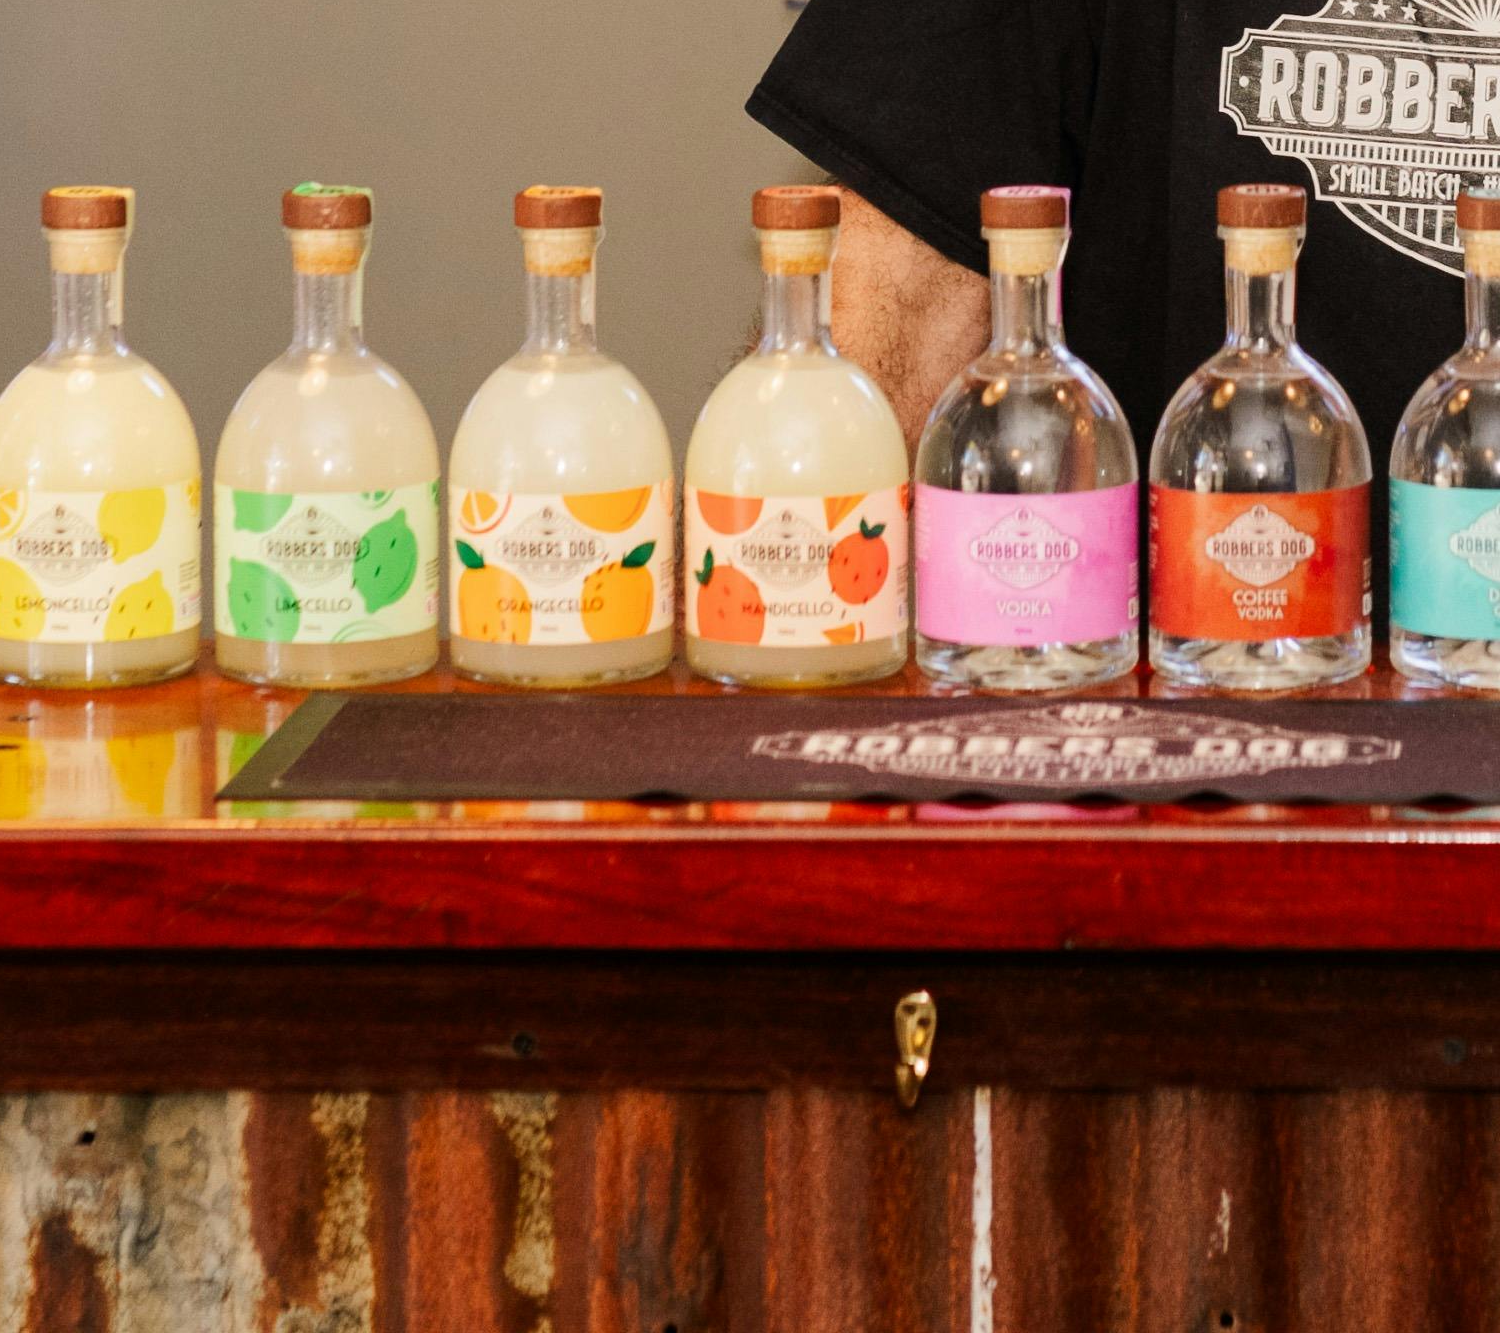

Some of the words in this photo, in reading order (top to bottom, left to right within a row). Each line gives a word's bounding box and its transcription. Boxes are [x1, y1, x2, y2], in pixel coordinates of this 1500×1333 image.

[1328, 164, 1391, 195] SMALL
[1399, 171, 1461, 201] BATCH
[502, 539, 563, 559] ROBBERS
[569, 539, 597, 558] DOG
[740, 543, 802, 561] ROBBERS
[807, 543, 835, 561] DOG
[976, 541, 1038, 560] ROBBERS
[1044, 541, 1071, 560] DOG
[1212, 540, 1275, 557] ROBBERS
[1280, 539, 1307, 556] DOG
[15, 596, 110, 613] LEMONCELLO
[275, 596, 351, 614] LIMECELLO
[496, 596, 605, 614] ORANGECELLO
[1231, 589, 1288, 606] COFFEE
[741, 601, 834, 616] MANDICELLO
[996, 599, 1053, 617] VODKA
[1235, 606, 1284, 620] VODKA
[800, 731, 1154, 763] ROBBERS
[1190, 734, 1352, 763] DOG
